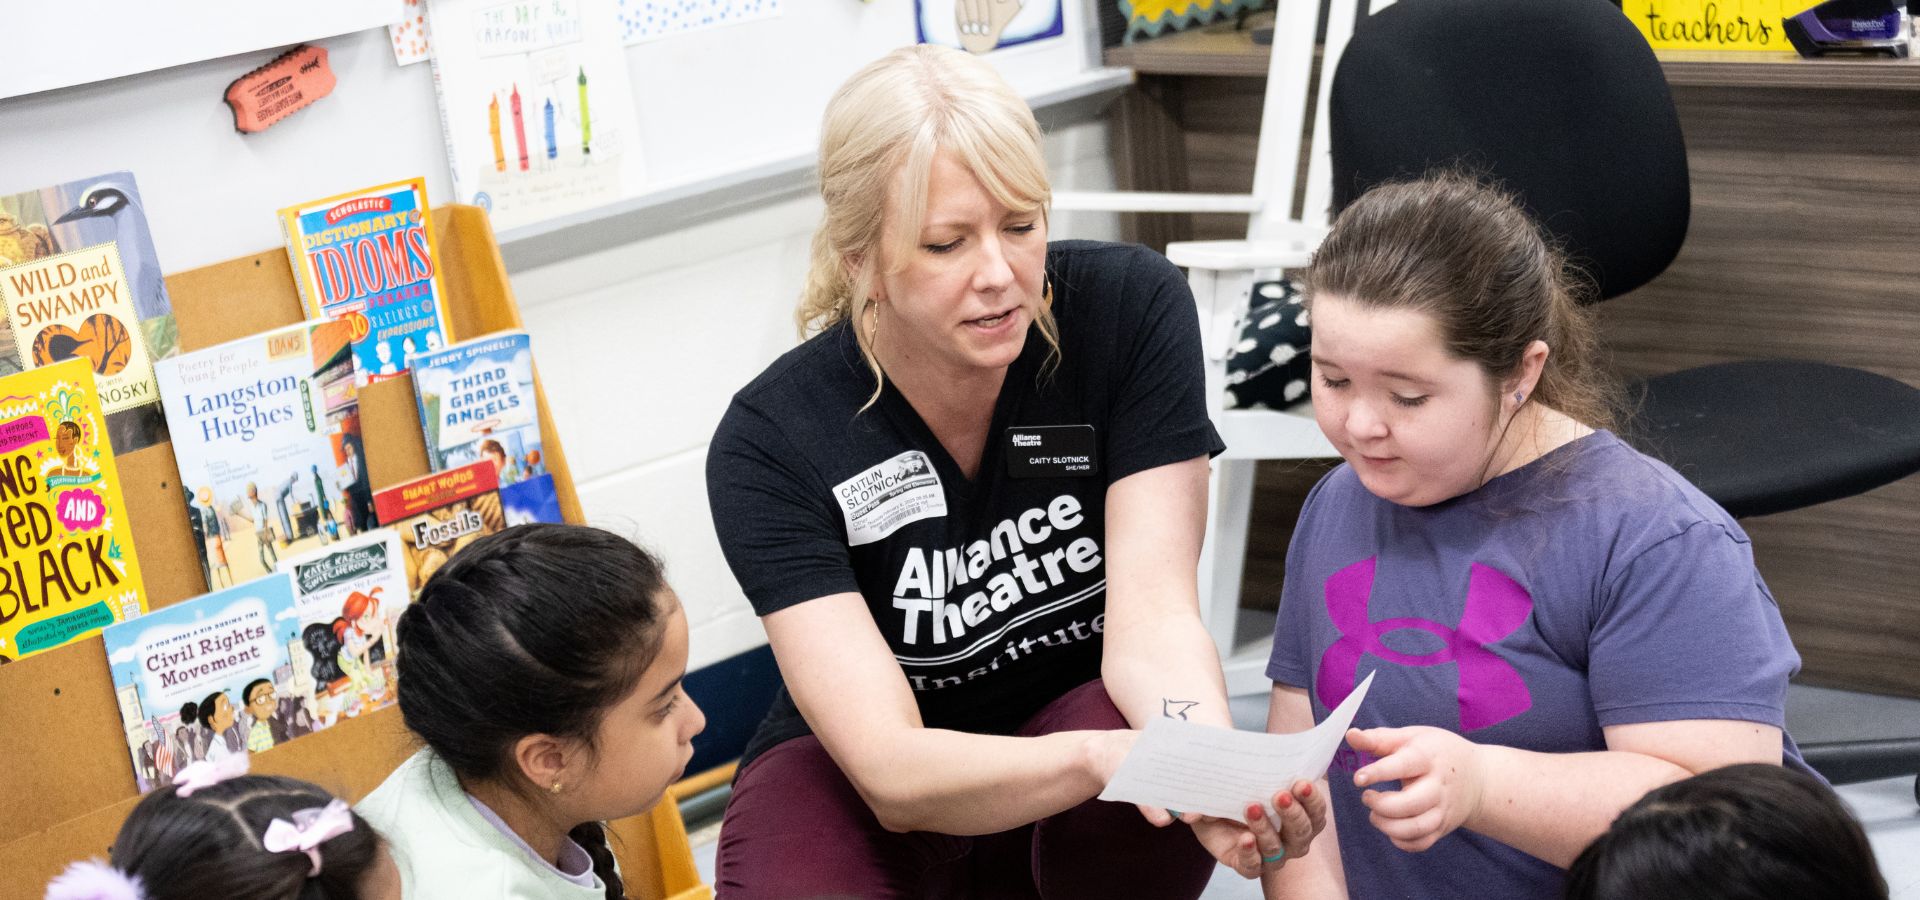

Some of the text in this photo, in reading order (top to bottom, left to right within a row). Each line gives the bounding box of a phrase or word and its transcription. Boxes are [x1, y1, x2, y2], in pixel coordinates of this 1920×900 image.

[1646, 0, 1772, 46] teachers
[330, 199, 385, 221] SCHOLASTIC
[303, 211, 408, 250] DICTIONARY
[10, 255, 112, 298] WILD and
[307, 227, 434, 307] IDIOMS
[17, 280, 119, 328] SWAMPY
[371, 304, 419, 329] SAYINGS
[377, 316, 435, 342] EXPRESSIONS
[268, 335, 301, 358] LOANS
[429, 339, 517, 369] JERRY SPINELLI
[178, 352, 236, 373] Poetry for
[179, 358, 259, 386] Young People
[448, 367, 506, 393] THIRD
[450, 382, 511, 409] GRADE
[184, 375, 298, 417] Langston
[446, 395, 520, 427] ANGELS
[201, 404, 295, 443] Hughes
[1012, 434, 1041, 442] Alliance
[1029, 456, 1090, 465] CAITY SLOTNICK
[402, 481, 437, 501] SMART
[438, 470, 475, 490] WORDS
[841, 469, 883, 499] CAITLIN
[846, 472, 903, 510] SLOTNICK
[64, 497, 97, 523] AND
[851, 507, 868, 520] Guest
[413, 511, 482, 547] Fossils
[893, 495, 1084, 599] Alliance
[0, 534, 120, 627] BLACK
[303, 551, 370, 580] KATIE KAZOO
[304, 560, 369, 591] SWITCHEROO
[892, 537, 1103, 645] Theatre
[156, 639, 170, 649] YOU
[172, 632, 192, 644] WERE
[200, 625, 213, 635] KID
[215, 617, 243, 631] DURING
[245, 611, 259, 620] THE
[146, 624, 266, 673] Civil Rights
[160, 646, 261, 688] Movement
